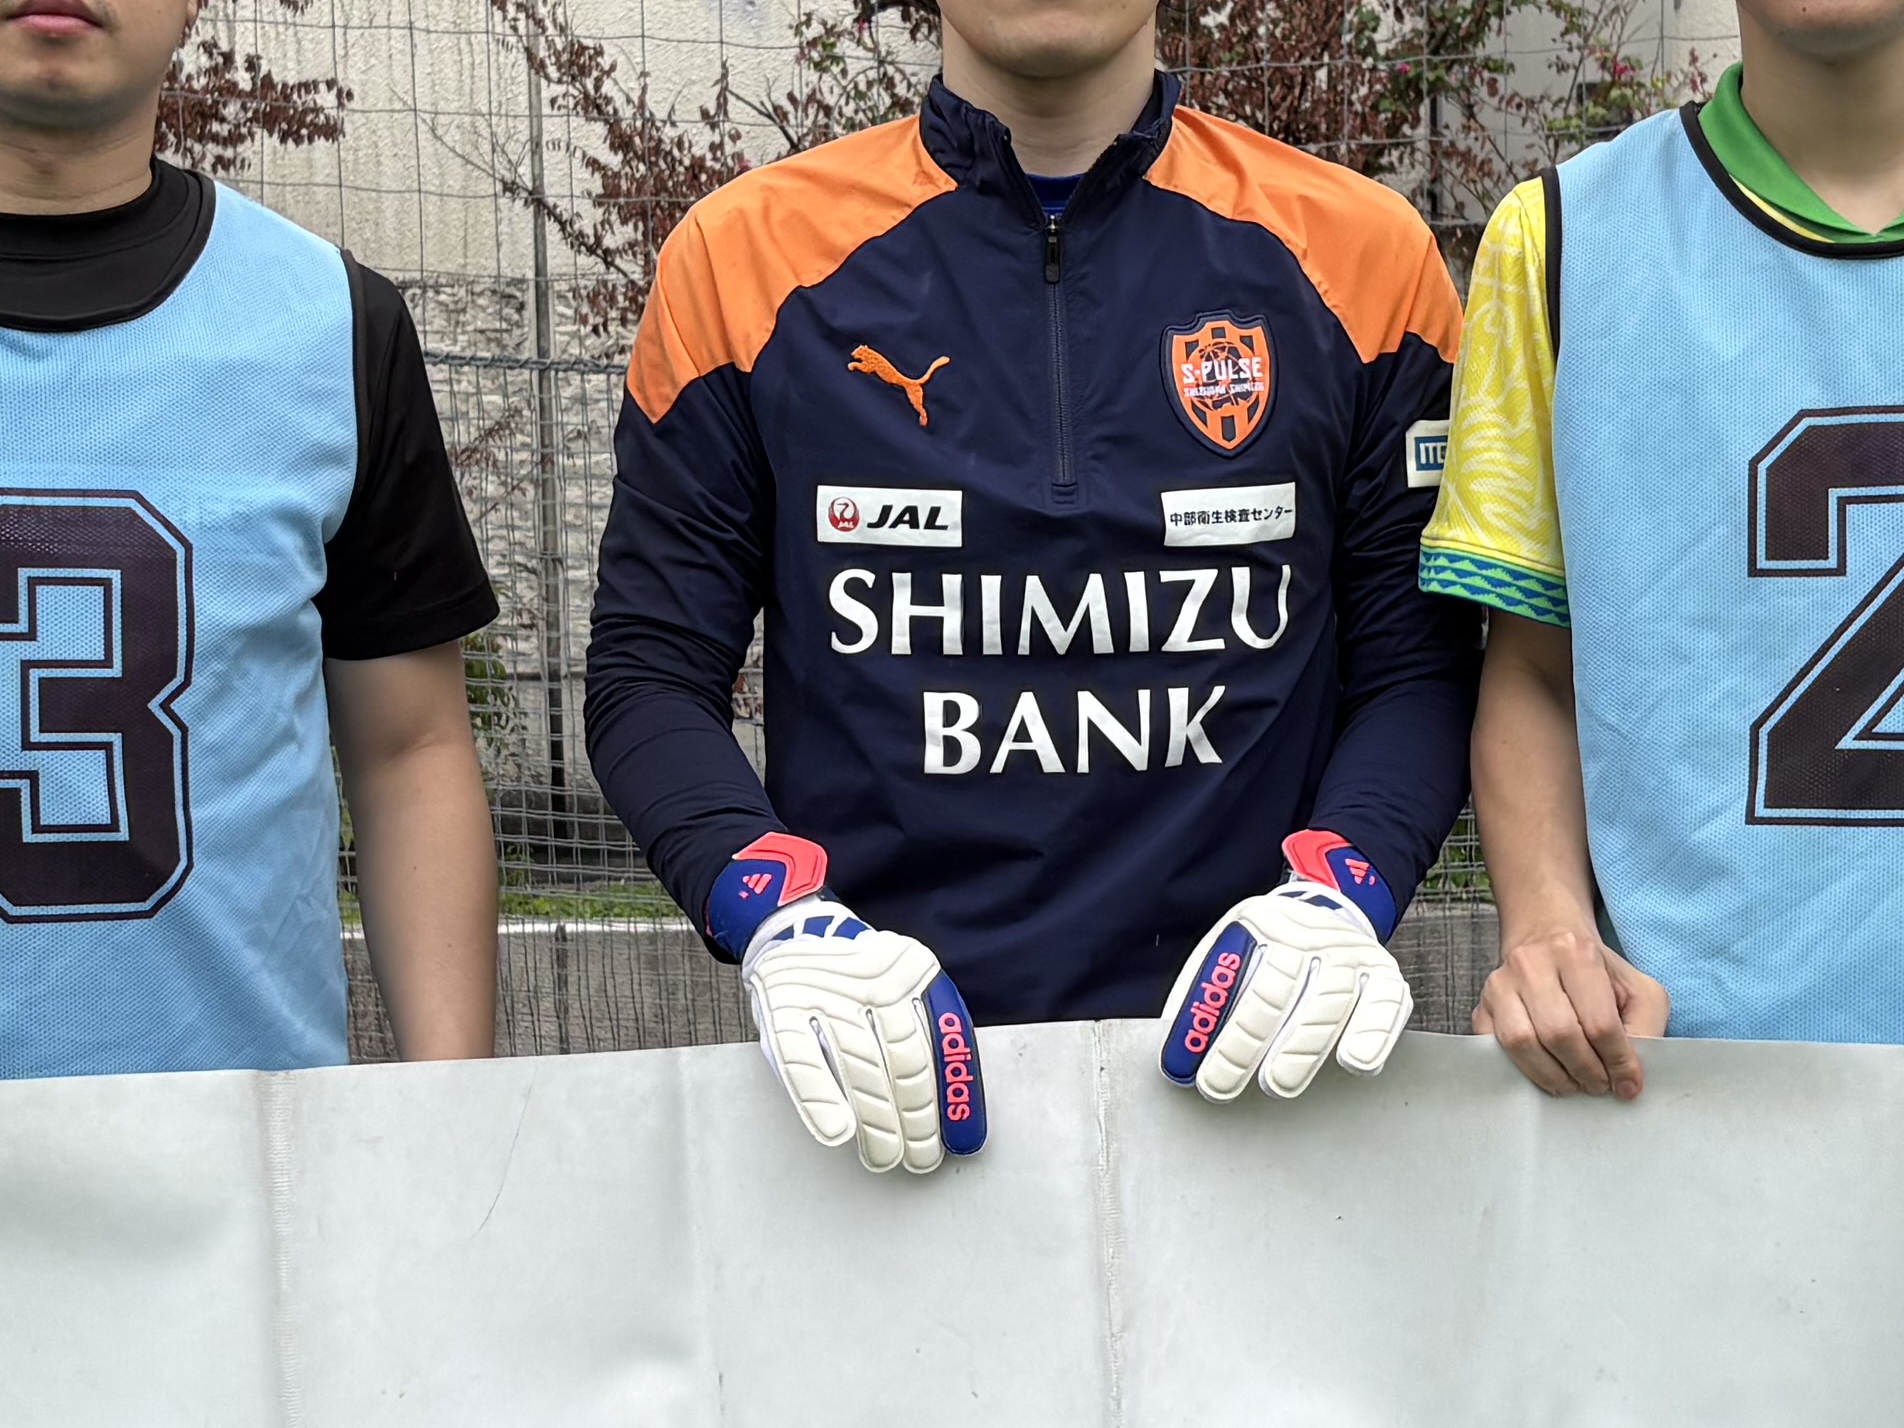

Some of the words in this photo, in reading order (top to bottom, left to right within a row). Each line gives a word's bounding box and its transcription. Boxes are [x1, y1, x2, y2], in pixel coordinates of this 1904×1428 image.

[1181, 357, 1263, 383] S-PULSE
[866, 504, 949, 530] JAL
[1170, 505, 1293, 527] 中部衛生検査センター
[829, 563, 1293, 656] SHIMIZU
[922, 684, 1226, 775] BANK
[1184, 952, 1241, 1053] adidas
[938, 1012, 972, 1121] adidas
